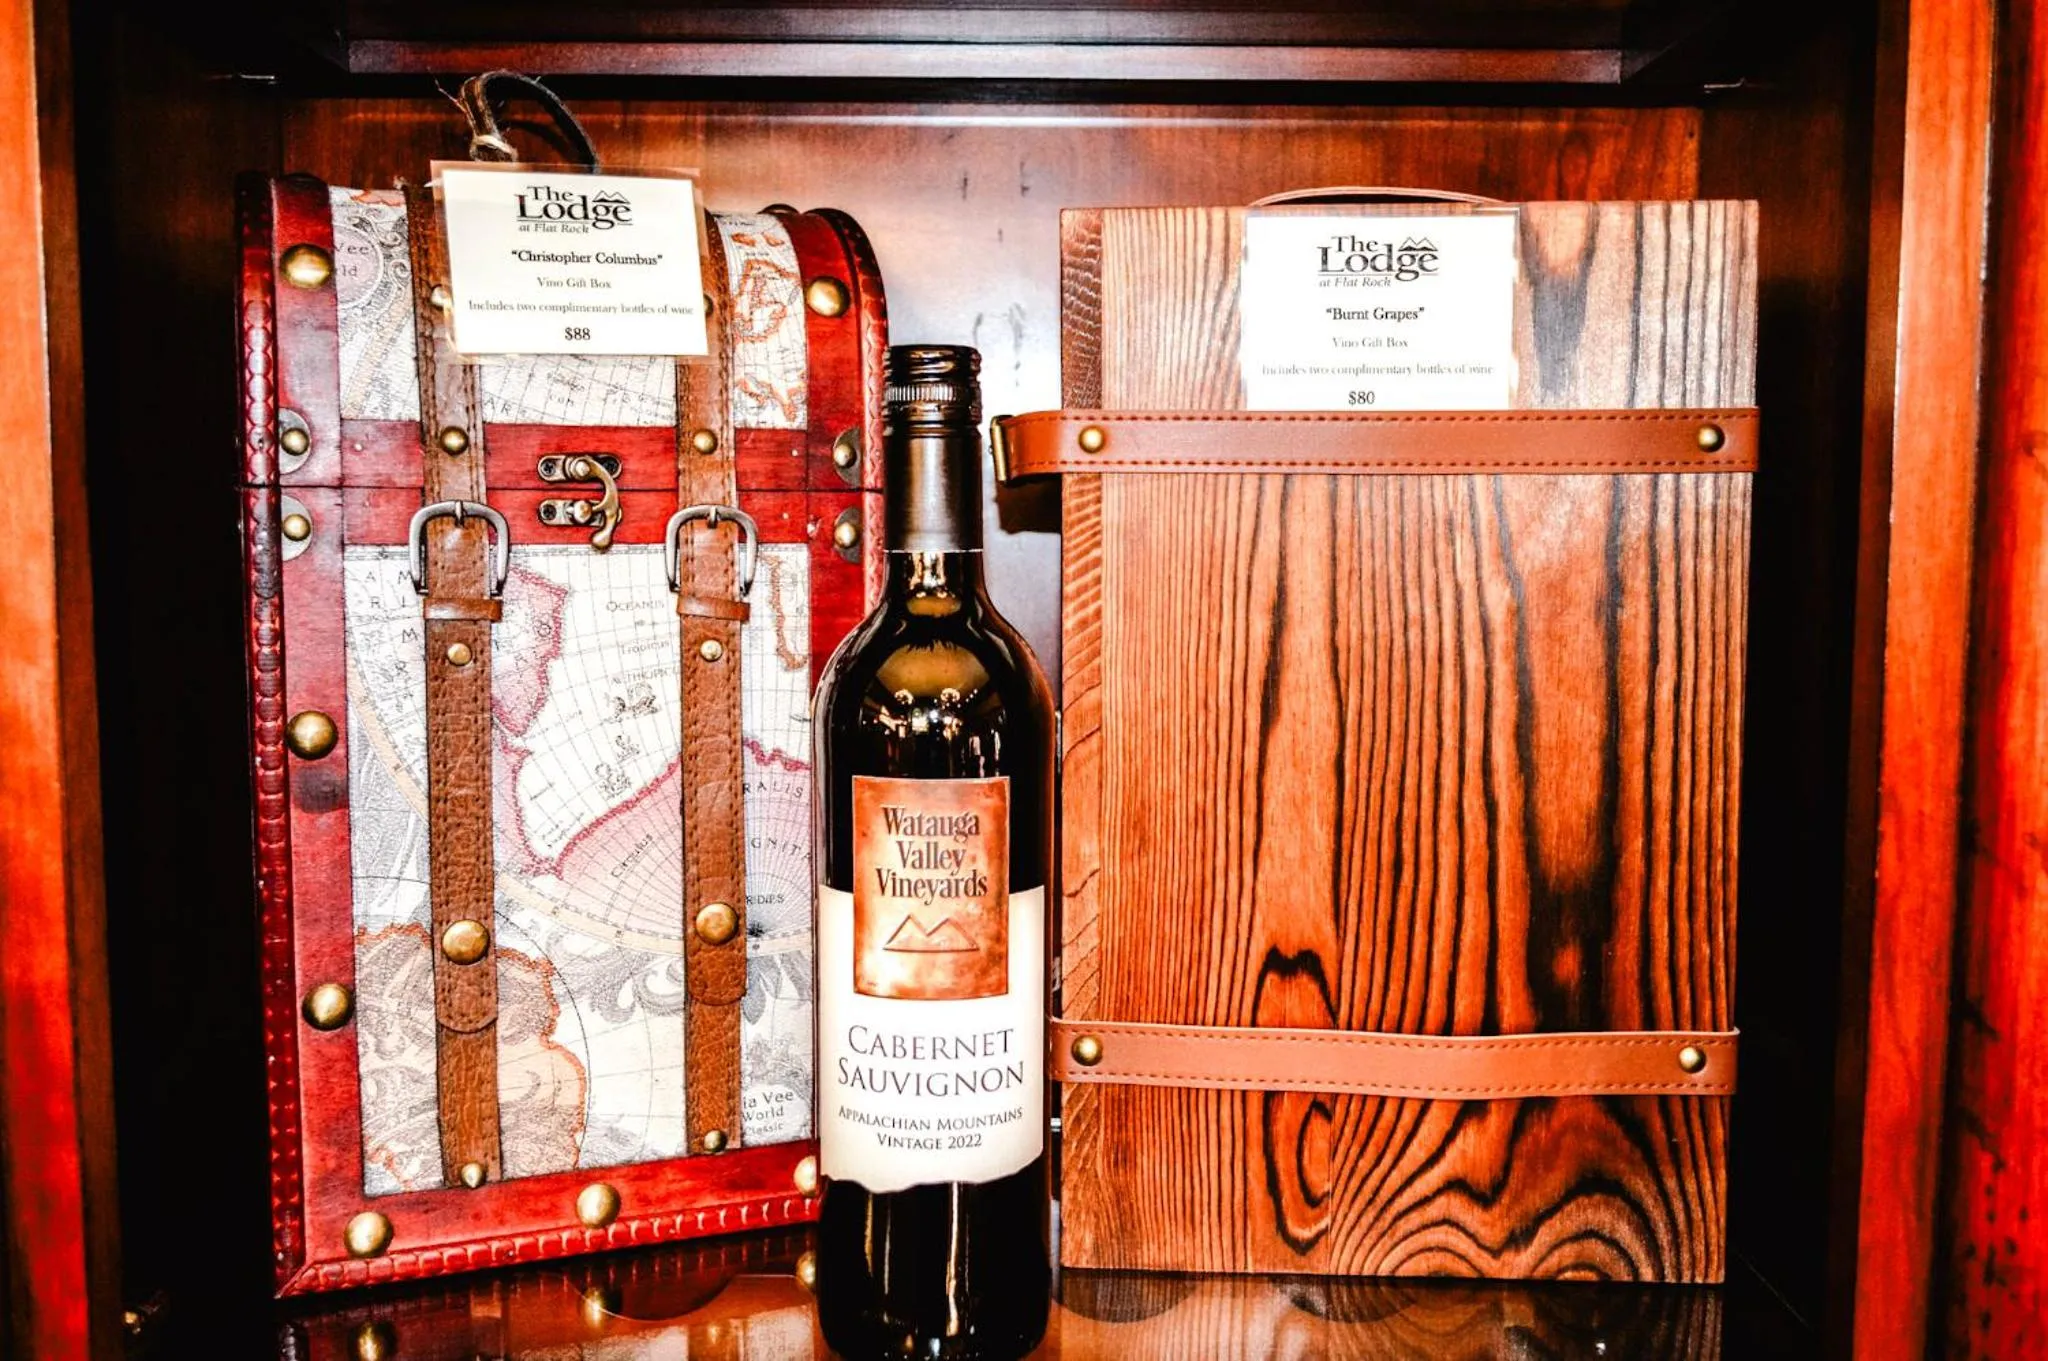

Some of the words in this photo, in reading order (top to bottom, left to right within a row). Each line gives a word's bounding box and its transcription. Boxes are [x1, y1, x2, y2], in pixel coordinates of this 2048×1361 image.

[526, 186, 574, 202] The
[514, 192, 632, 230] Lodge
[518, 224, 530, 233] at
[534, 223, 558, 234] Flat
[561, 224, 590, 234] Rock
[1331, 235, 1379, 252] The
[1317, 243, 1439, 282] Lodge
[537, 277, 563, 289] Vino
[566, 277, 587, 289] Gift
[591, 278, 612, 290] Box
[1318, 278, 1330, 288] at
[1334, 278, 1358, 288] Flat
[1362, 277, 1392, 288] Rock
[468, 300, 515, 312] Includes
[517, 302, 536, 312] two
[538, 302, 618, 316] complimentary
[621, 302, 655, 314] bottles
[658, 303, 669, 314] of
[671, 306, 694, 315] wine
[564, 327, 592, 341] $88
[1332, 337, 1359, 348] Vino
[1362, 337, 1383, 348] Gift
[1386, 337, 1409, 348] Box
[1262, 364, 1307, 376] Includes
[1310, 366, 1329, 376] two
[1331, 364, 1412, 378] complimentary
[1416, 364, 1452, 375] bottles
[1454, 364, 1466, 375] of
[1469, 366, 1493, 375] wine
[1348, 391, 1376, 406] $80
[882, 807, 980, 843] Watauga
[896, 841, 967, 875] Valley
[876, 868, 988, 906] Vineyards
[848, 1025, 1014, 1060] CABERNET
[838, 1057, 1024, 1097] SAUVIGNON
[762, 1091, 794, 1104] Vee
[838, 1106, 931, 1131] APPALACHIAN
[937, 1107, 1023, 1130] MOUNTAINS
[877, 1133, 942, 1150] VINTAGE
[948, 1134, 983, 1150] 2022
